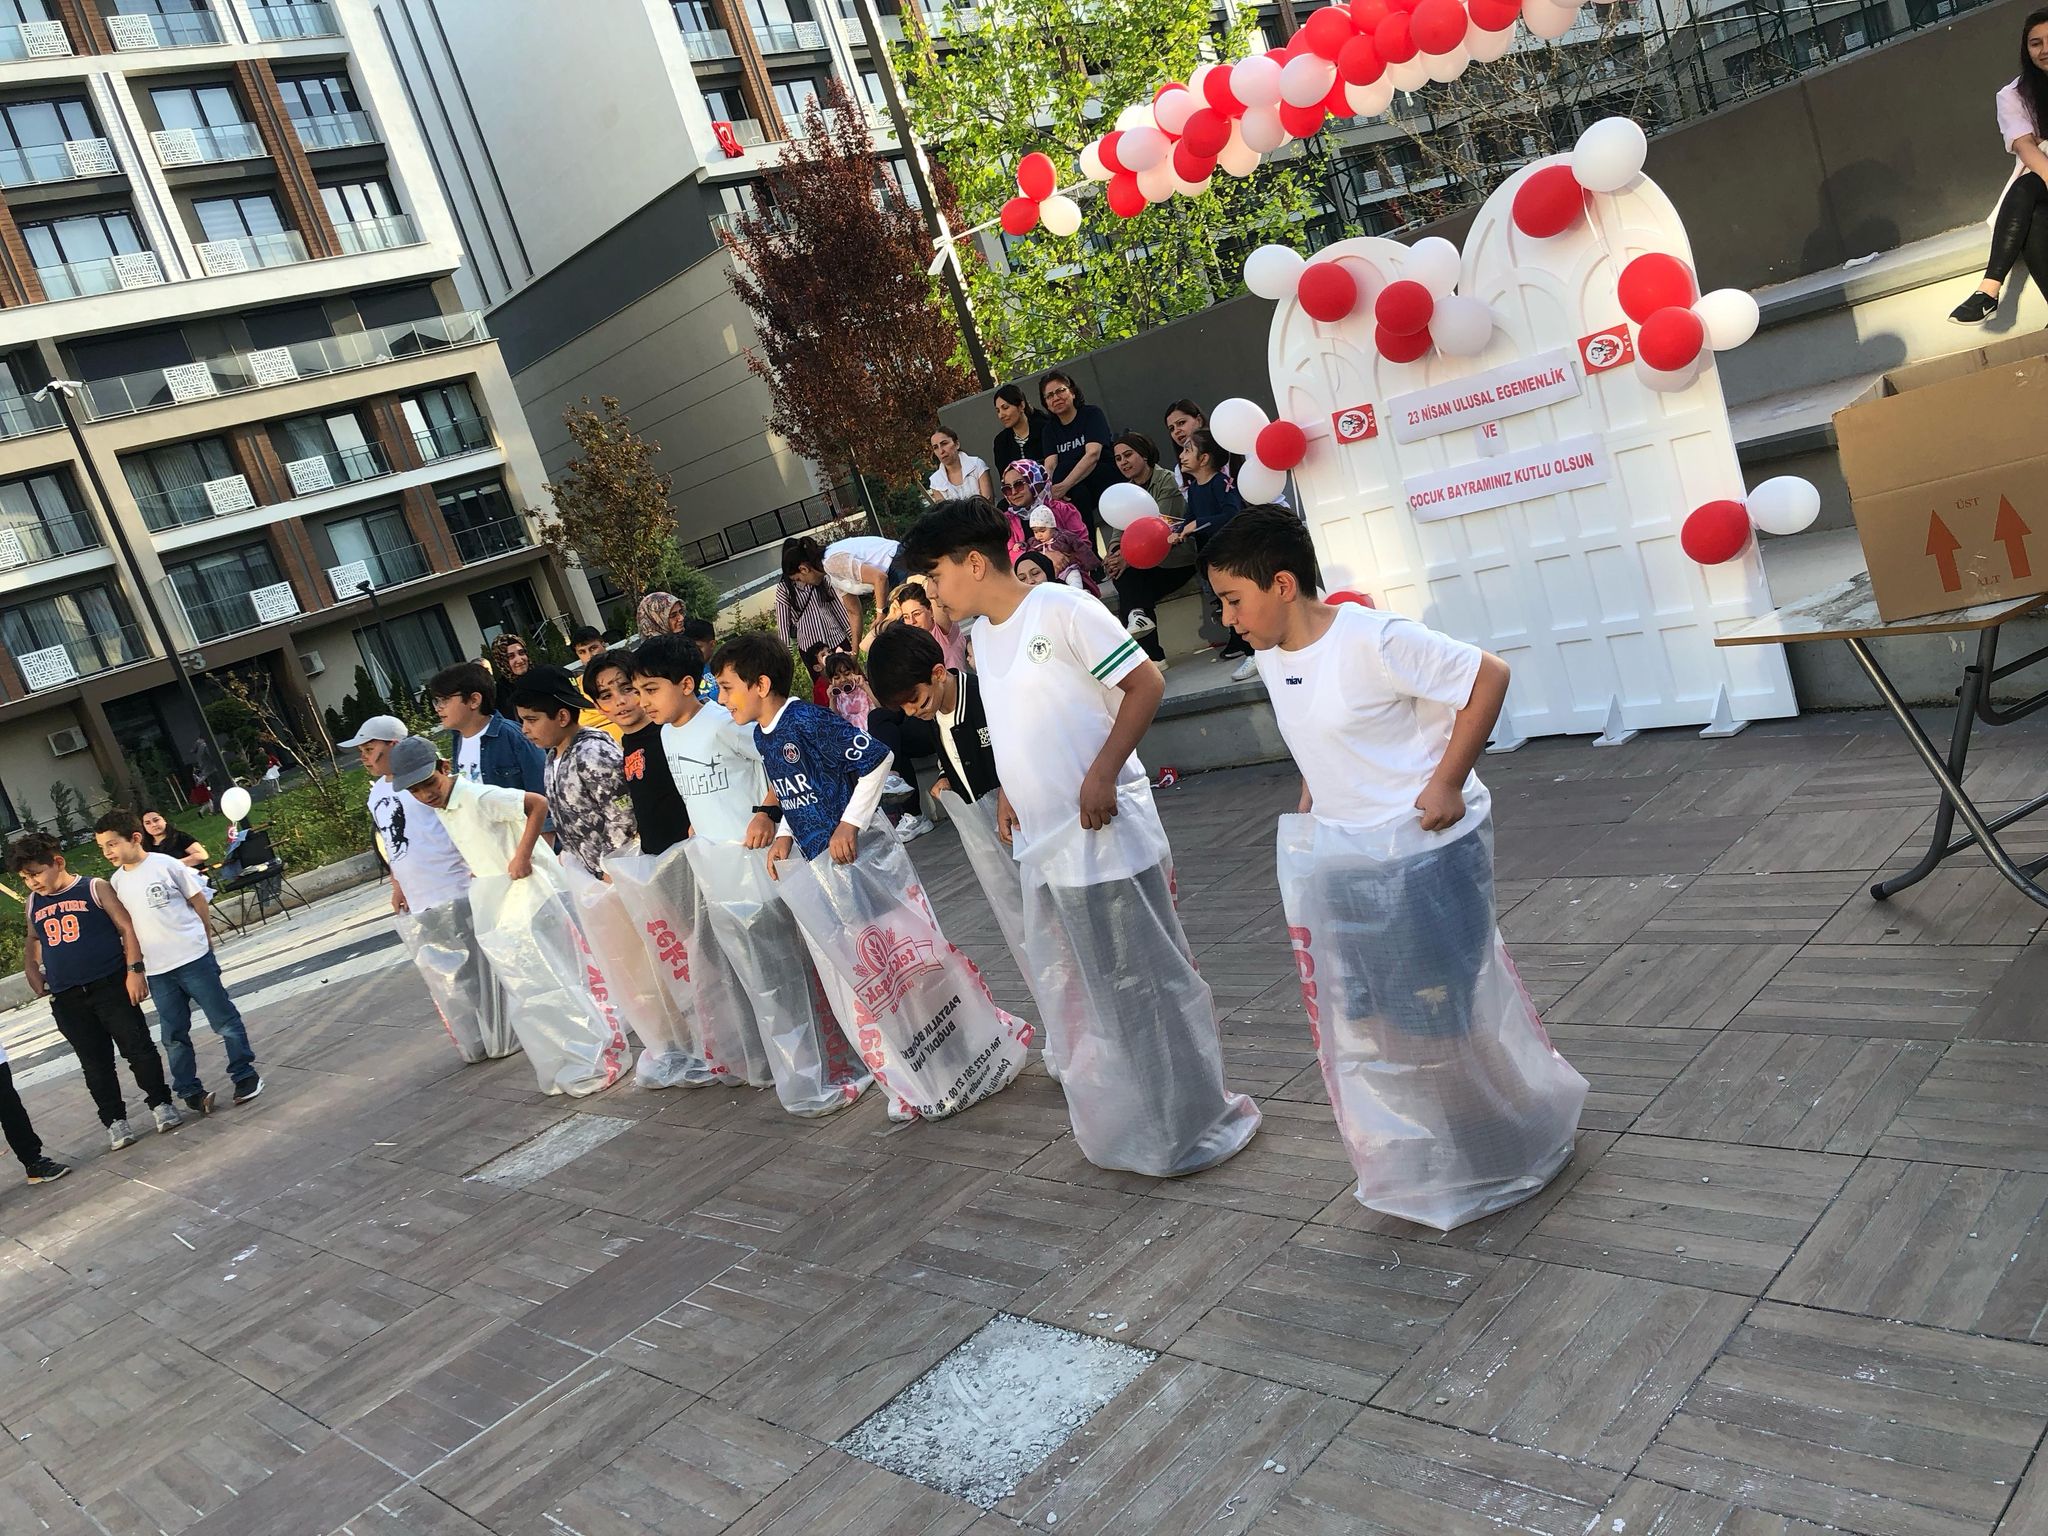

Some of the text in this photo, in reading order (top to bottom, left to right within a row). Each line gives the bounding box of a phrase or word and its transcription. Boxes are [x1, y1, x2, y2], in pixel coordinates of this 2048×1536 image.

[1407, 367, 1566, 426] 23 NİSAN ULUSAL EGEMENLİK
[1482, 423, 1498, 439] VE
[1409, 452, 1594, 511] ÇOCUK BAYRAMINIZ KUTLU OLSUN
[1285, 675, 1303, 685] miav
[772, 773, 812, 797] ATAR
[35, 899, 89, 923] NEW YORK
[43, 913, 80, 947] 99
